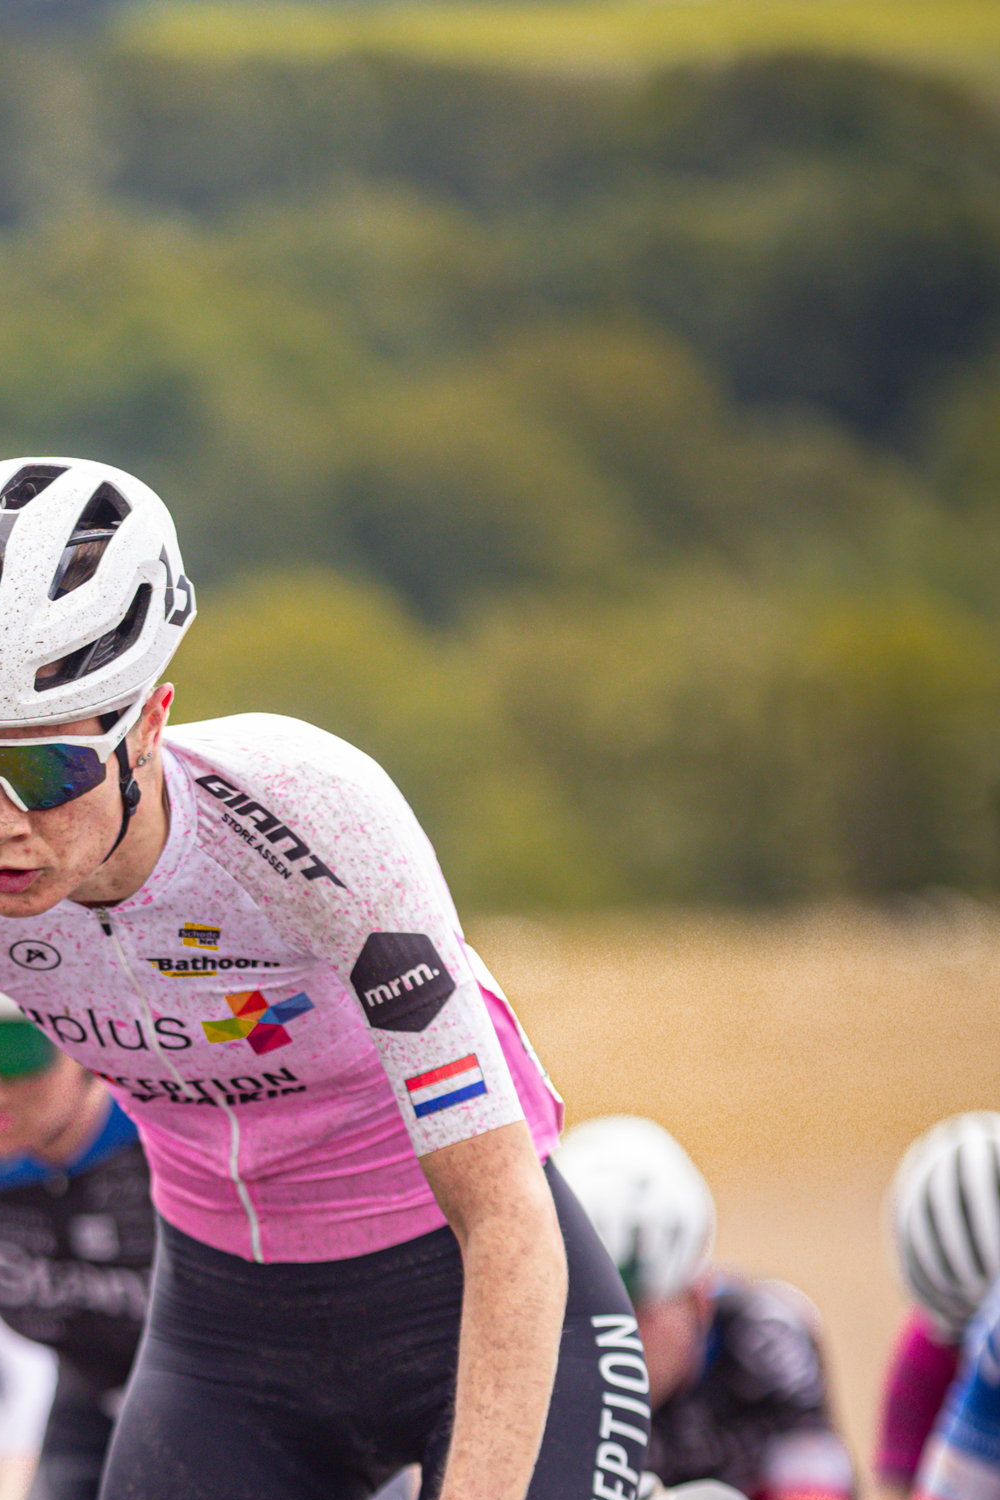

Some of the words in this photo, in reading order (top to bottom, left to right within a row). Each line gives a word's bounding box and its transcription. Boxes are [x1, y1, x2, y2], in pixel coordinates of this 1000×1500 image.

[195, 775, 348, 890] GIANT
[221, 812, 257, 847] STORE
[253, 844, 292, 880] ASSEN
[363, 962, 441, 1008] mrm.
